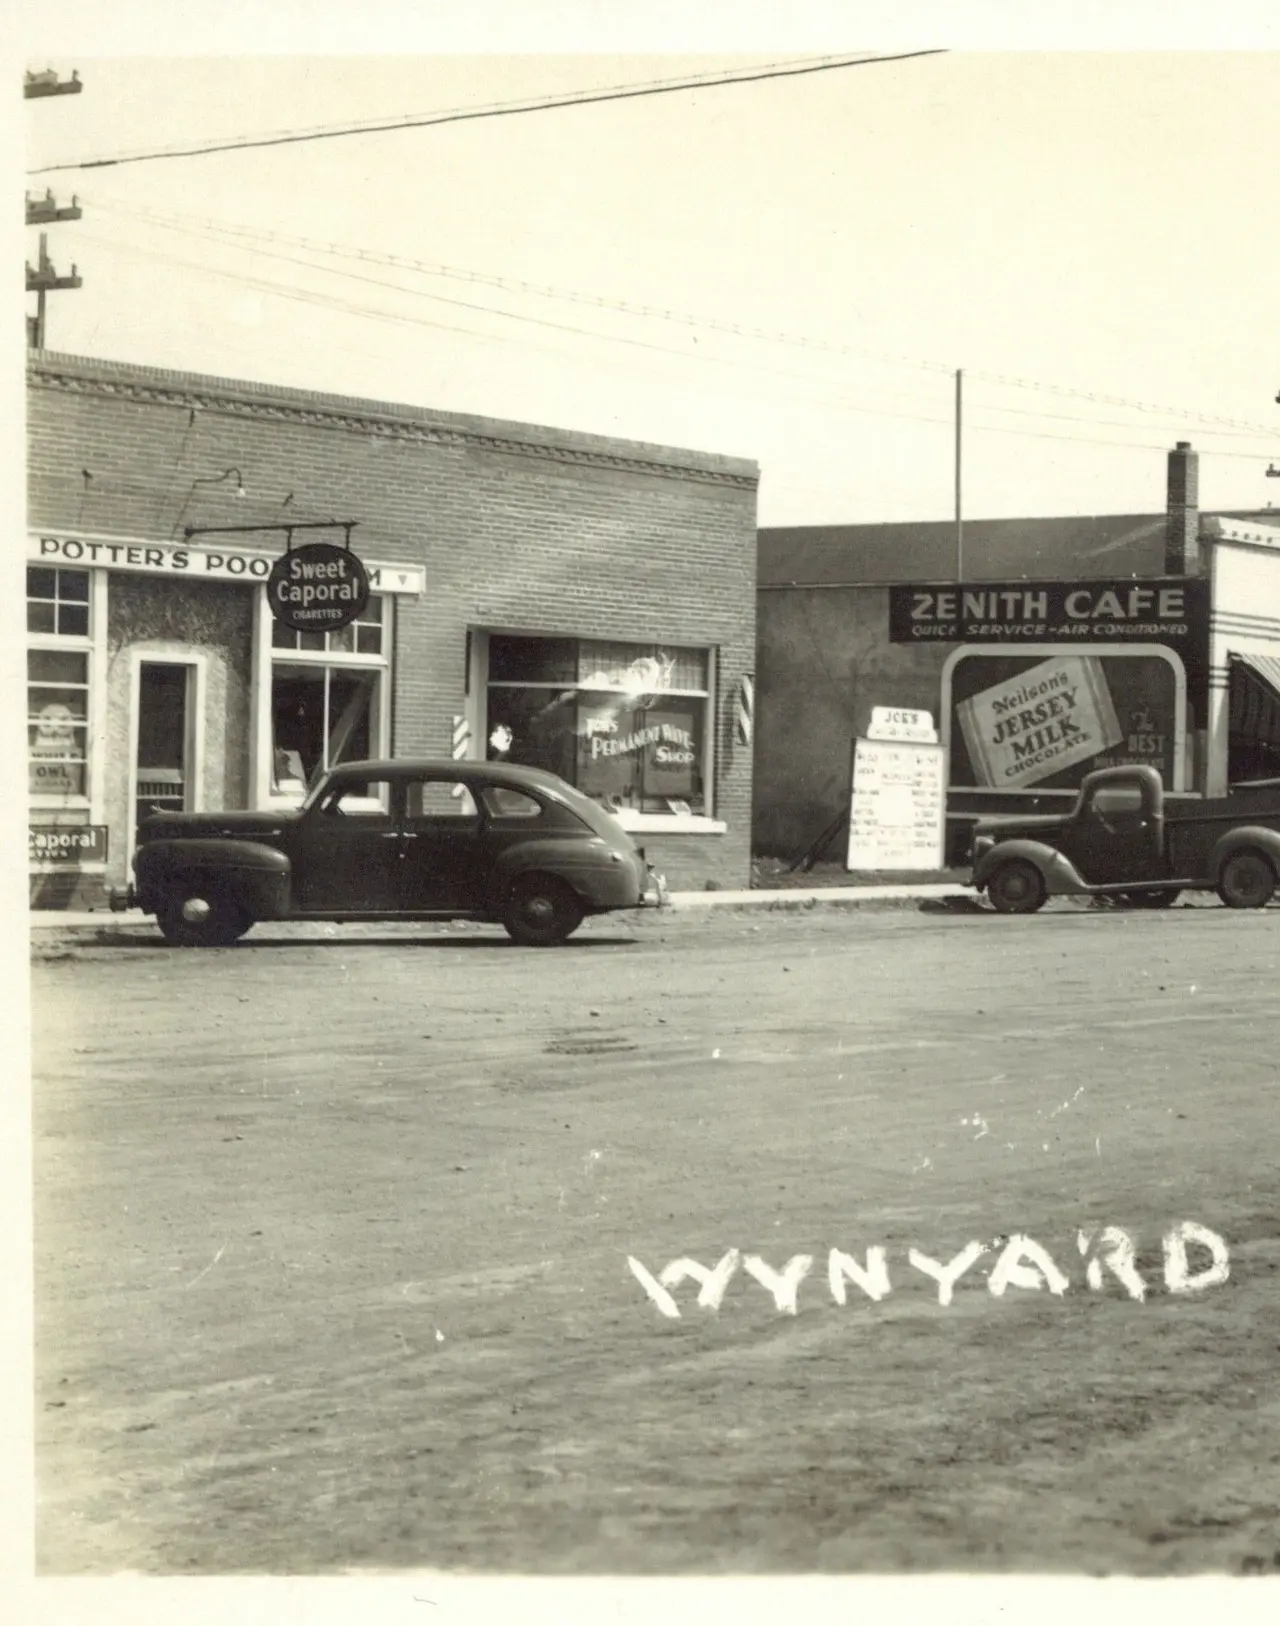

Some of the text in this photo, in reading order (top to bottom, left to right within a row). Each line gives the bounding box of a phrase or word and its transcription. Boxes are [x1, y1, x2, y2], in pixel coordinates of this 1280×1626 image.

[40, 538, 189, 569] POTTER'S
[207, 554, 274, 576] POO
[290, 558, 347, 579] Sweet
[277, 577, 358, 606] Caporal
[911, 589, 1185, 619] ZENITH CAFE
[293, 609, 343, 620] CIGARETTES
[992, 672, 1068, 715] Neilson's
[992, 685, 1078, 744] JERSEY
[1005, 732, 1092, 777] CHOCOLATE
[1010, 713, 1080, 761] MILK
